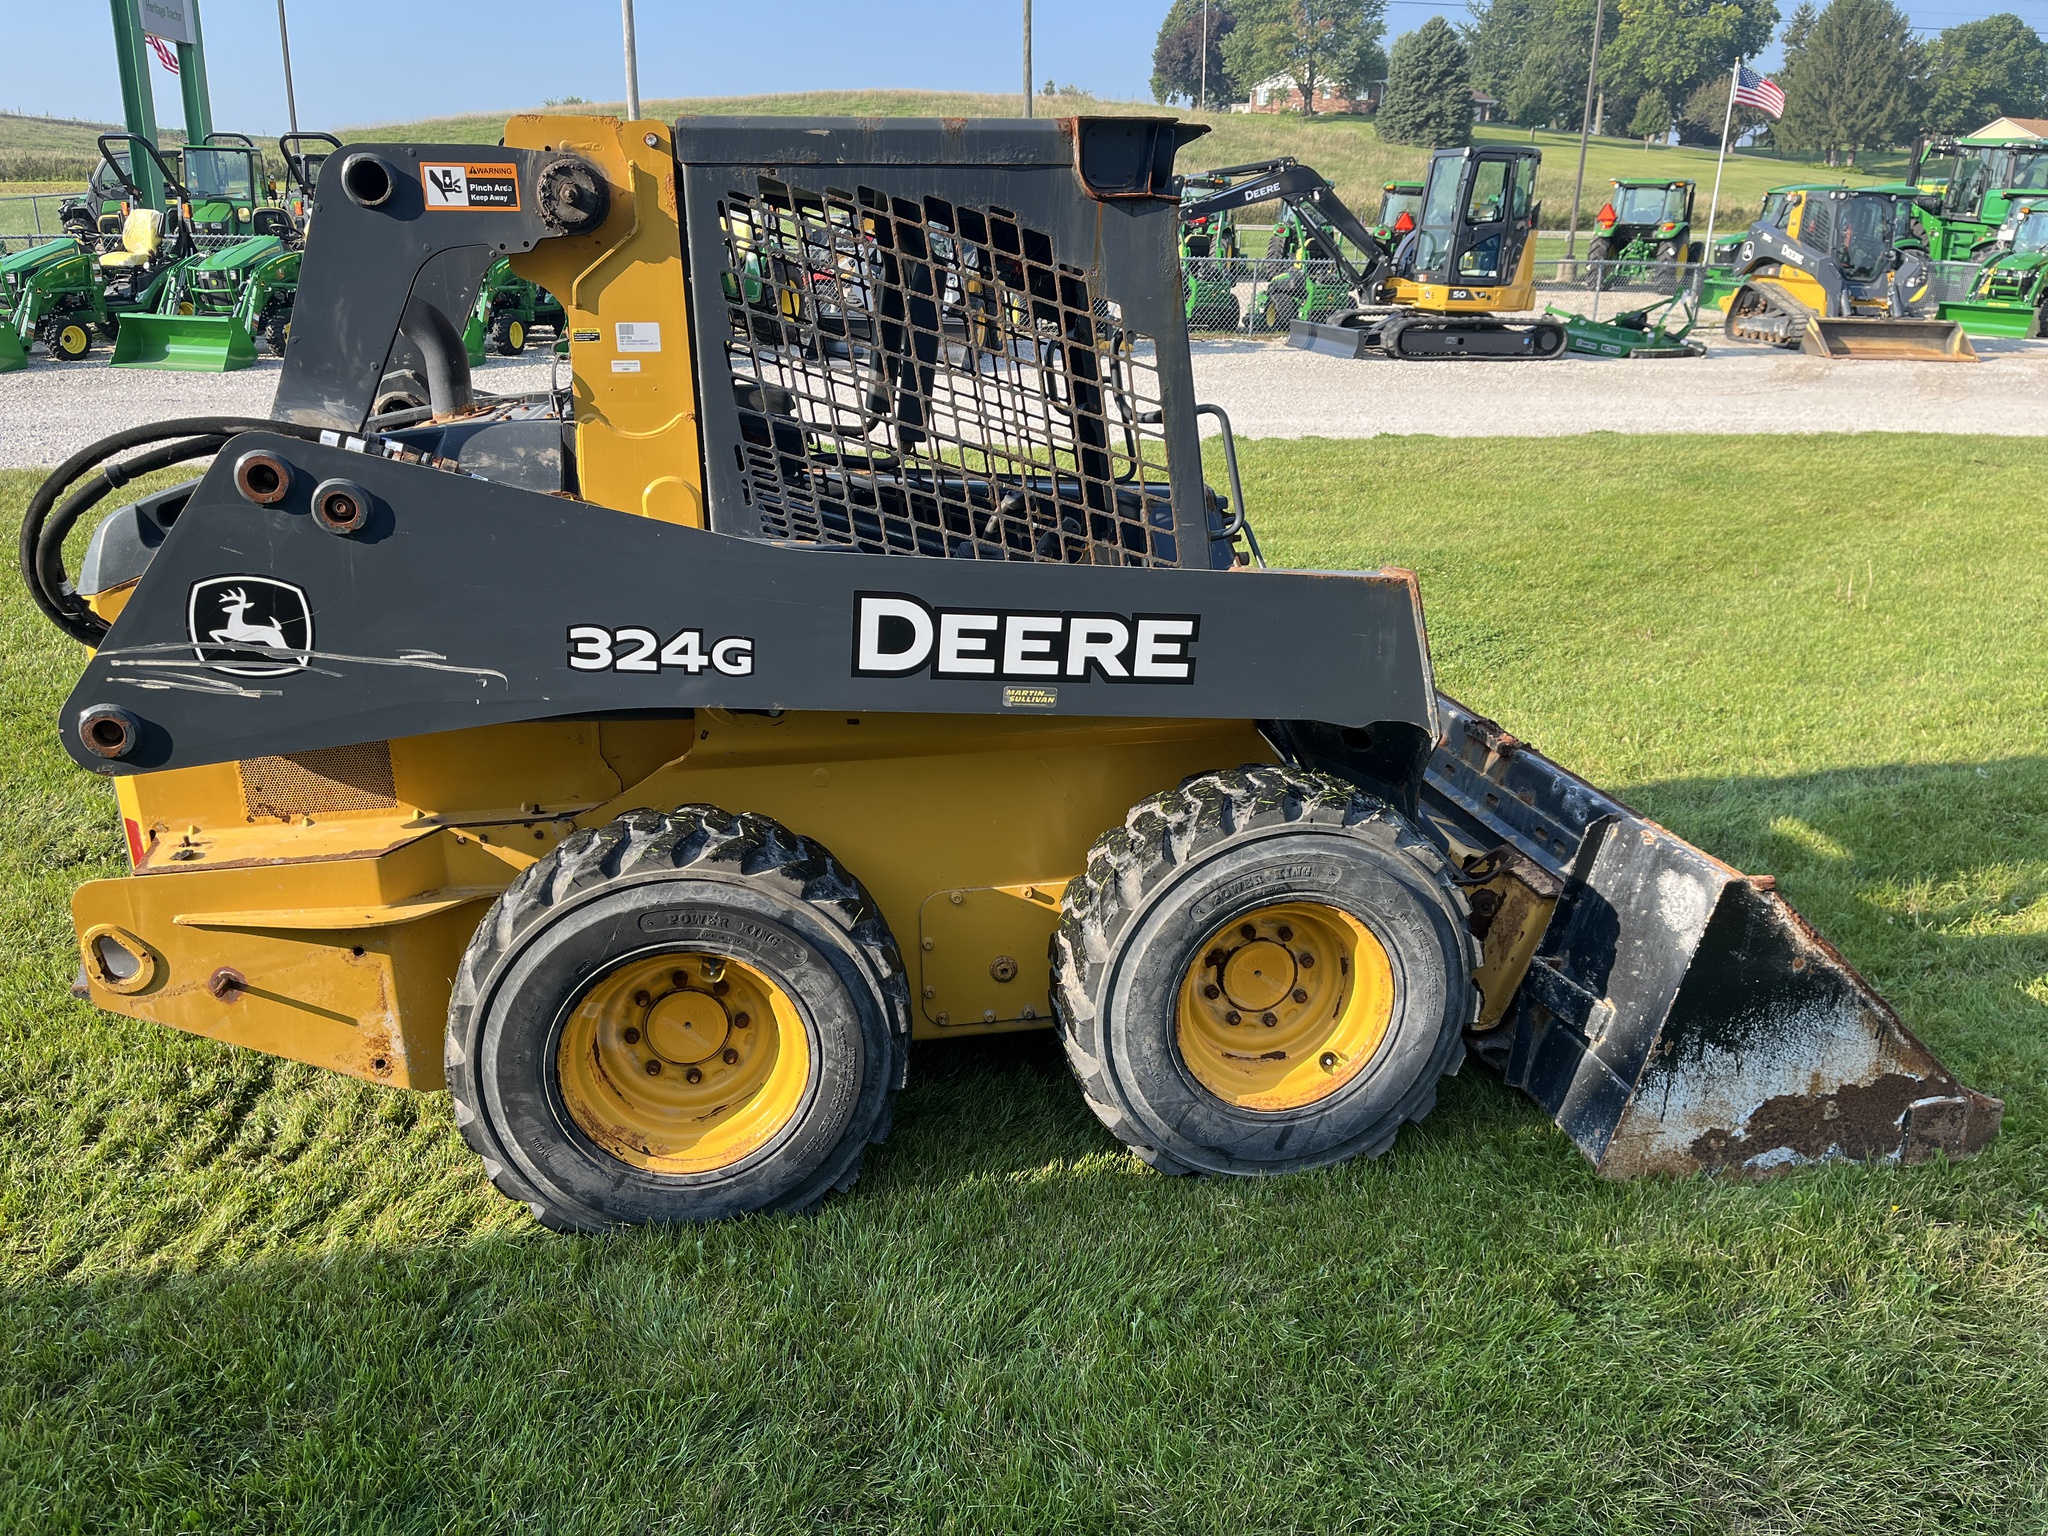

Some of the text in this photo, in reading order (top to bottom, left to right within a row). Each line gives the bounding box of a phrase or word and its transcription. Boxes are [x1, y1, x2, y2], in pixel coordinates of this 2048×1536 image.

[145, 0, 182, 22] Heritage Tractor
[469, 183, 493, 192] Pinch
[1244, 182, 1281, 201] DEERE
[470, 194, 508, 203] Keep Away
[1452, 290, 1467, 298] 50
[856, 594, 1197, 681] DEERE
[568, 625, 753, 676] 324G
[1008, 695, 1055, 704] SULLIVAN
[1212, 875, 1264, 906] POWER
[1274, 866, 1312, 880] KING
[667, 913, 730, 928] POWER
[739, 921, 780, 949] KING
